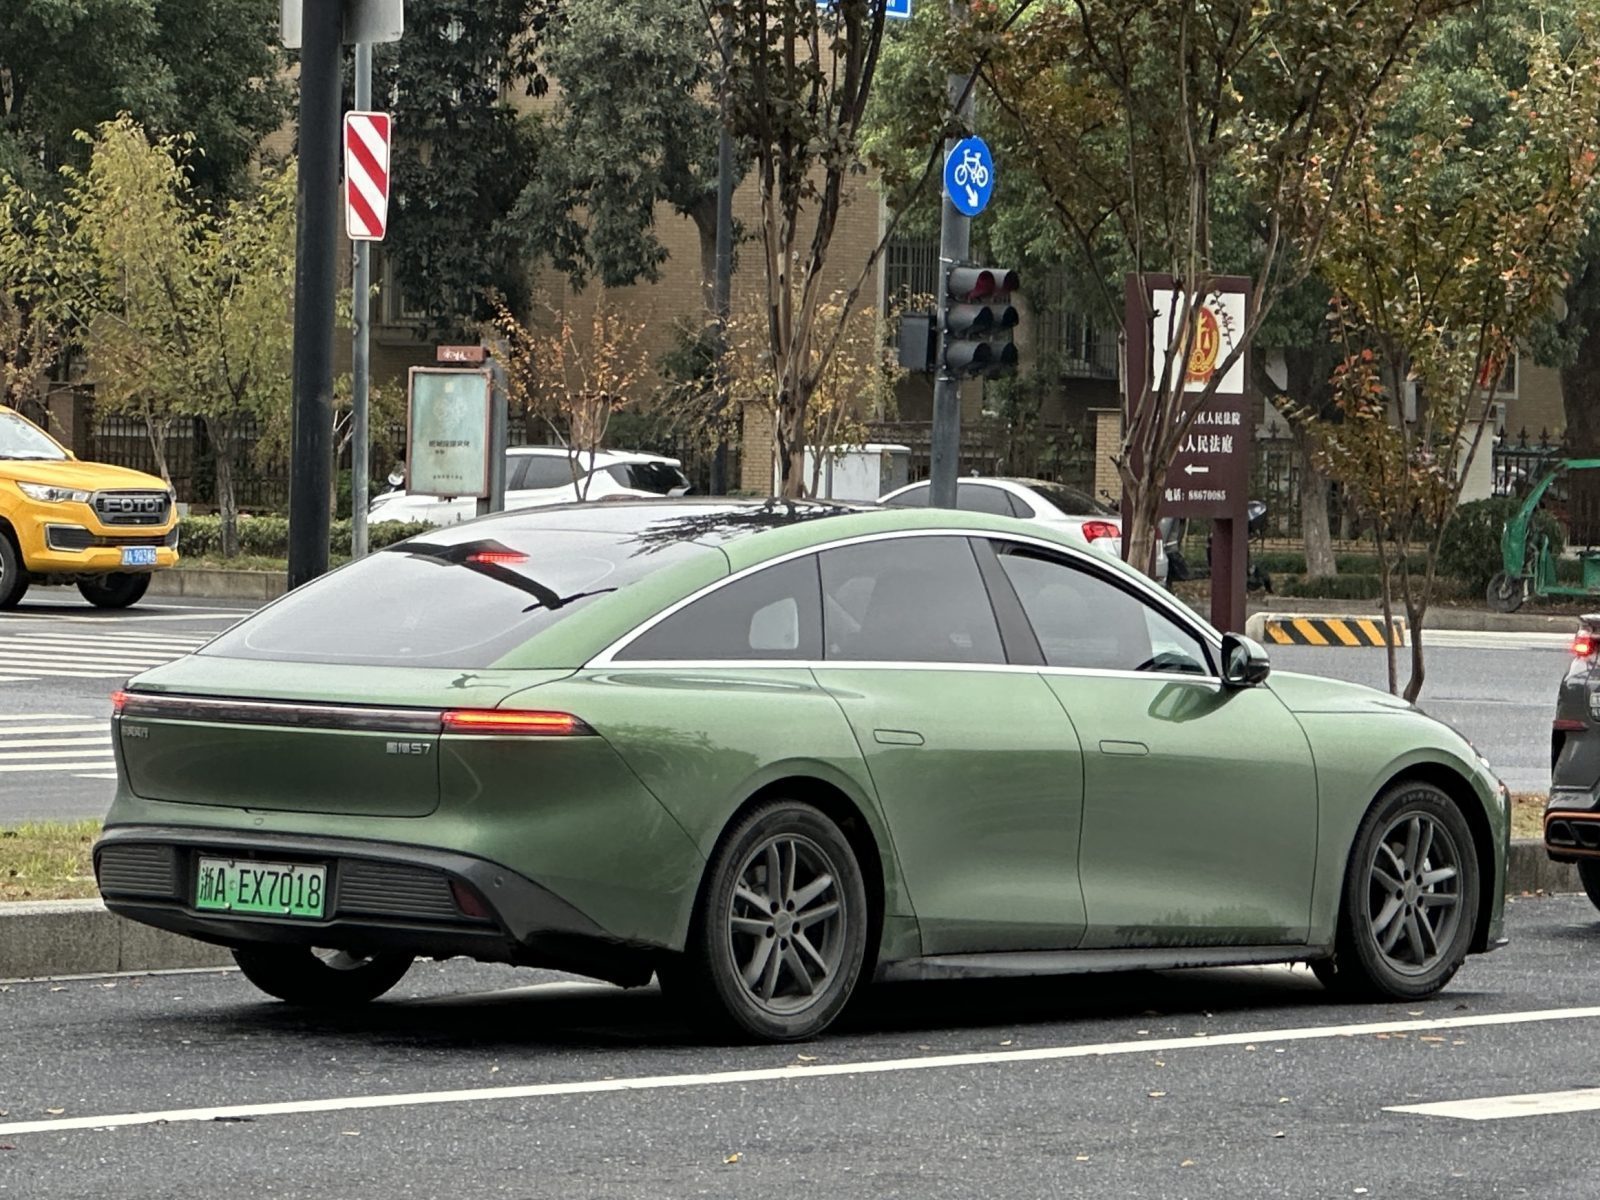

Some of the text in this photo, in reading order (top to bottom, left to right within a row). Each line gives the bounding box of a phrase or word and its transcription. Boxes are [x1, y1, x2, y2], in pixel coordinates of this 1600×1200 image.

[1179, 434, 1233, 453] 人民法庭
[237, 868, 321, 909] EX7018
